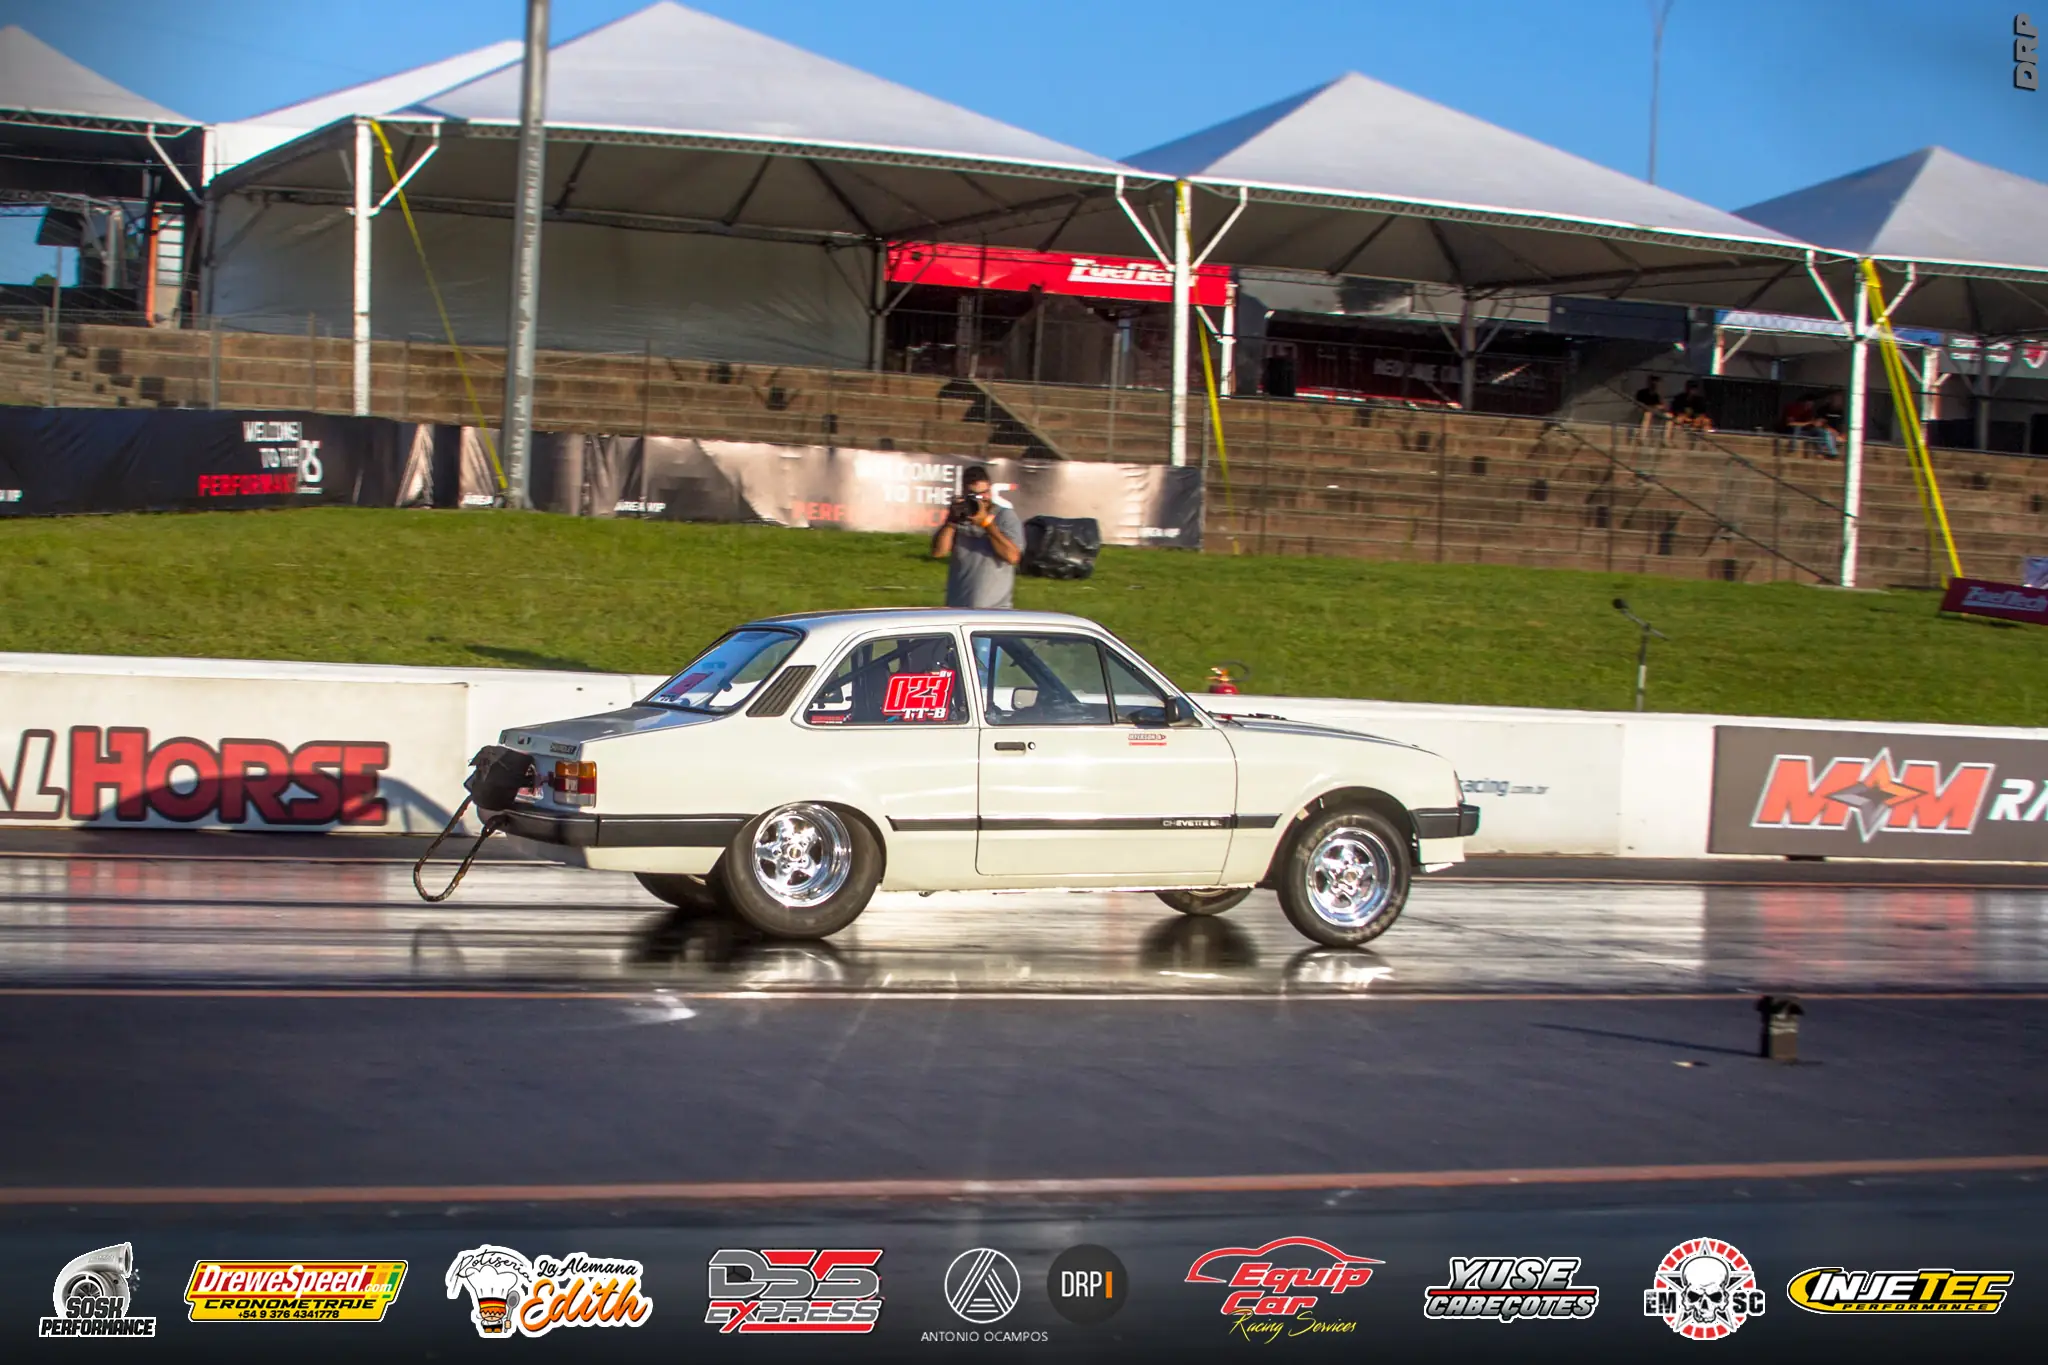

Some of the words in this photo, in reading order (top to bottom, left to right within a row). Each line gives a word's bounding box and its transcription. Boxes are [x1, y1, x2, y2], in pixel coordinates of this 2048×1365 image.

[914, 486, 953, 505] THE
[884, 676, 951, 712] 023
[902, 708, 946, 719] TT-B
[69, 725, 389, 826] HORSE
